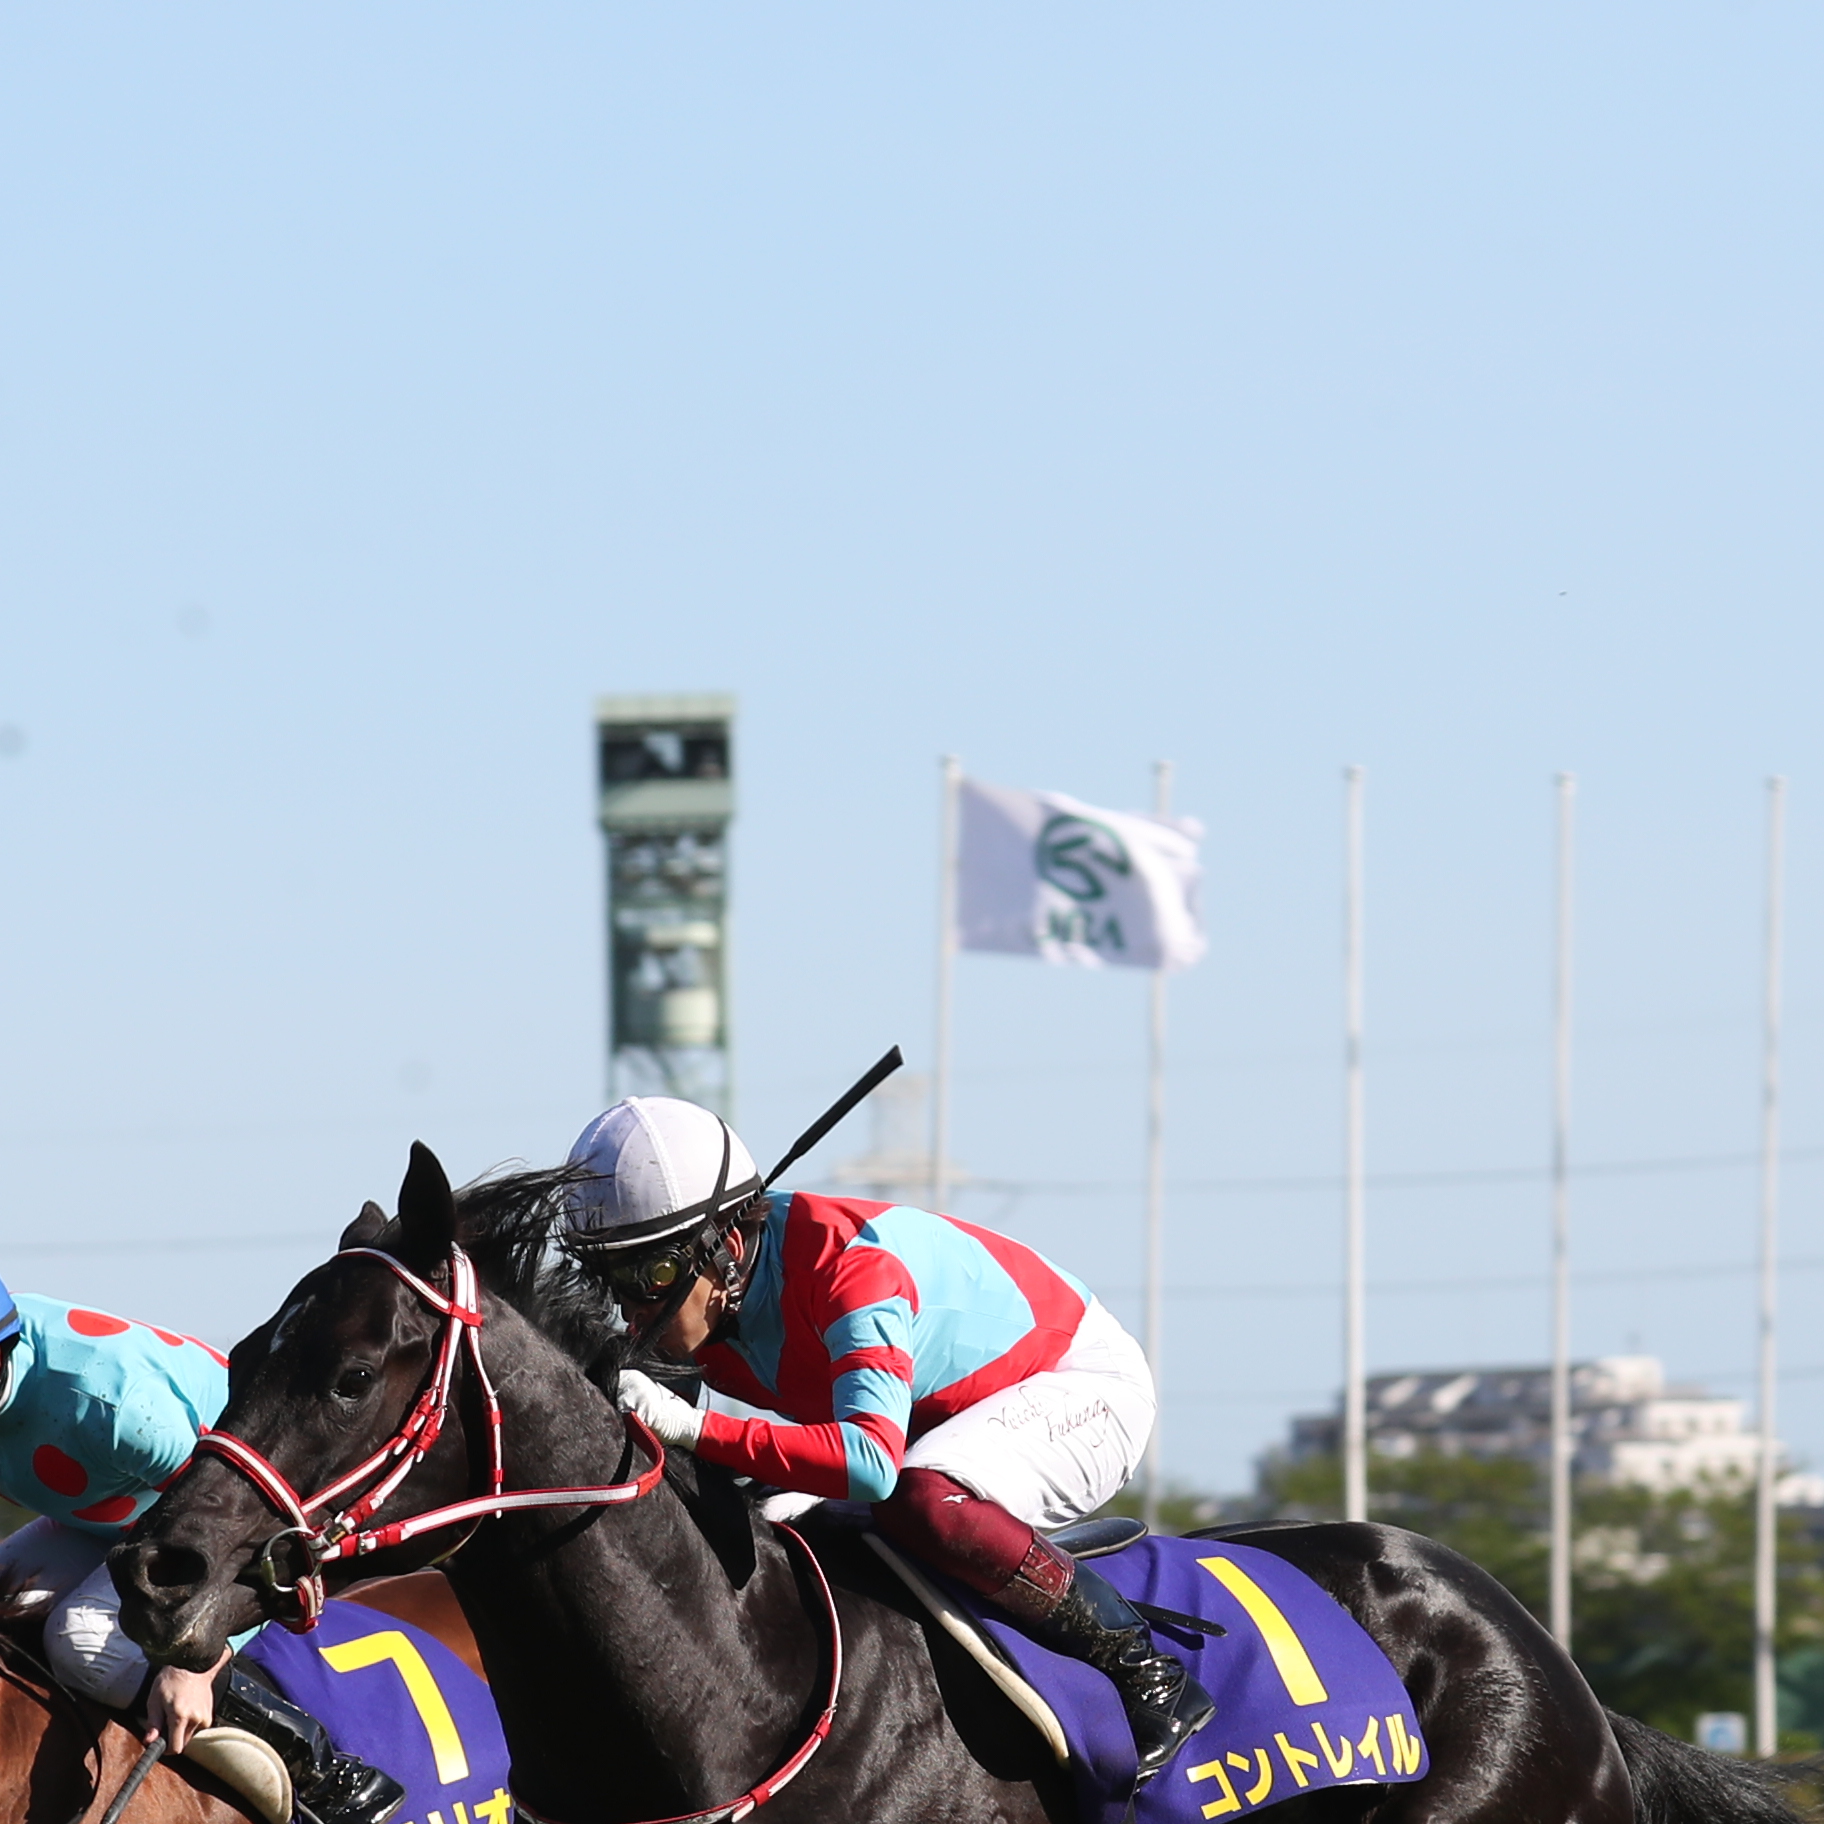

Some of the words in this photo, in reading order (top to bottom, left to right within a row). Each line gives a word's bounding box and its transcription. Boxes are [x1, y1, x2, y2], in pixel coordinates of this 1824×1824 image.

[1195, 1556, 1329, 1707] 1
[318, 1630, 470, 1785] 7
[1186, 1713, 1422, 1821] コントレイル
